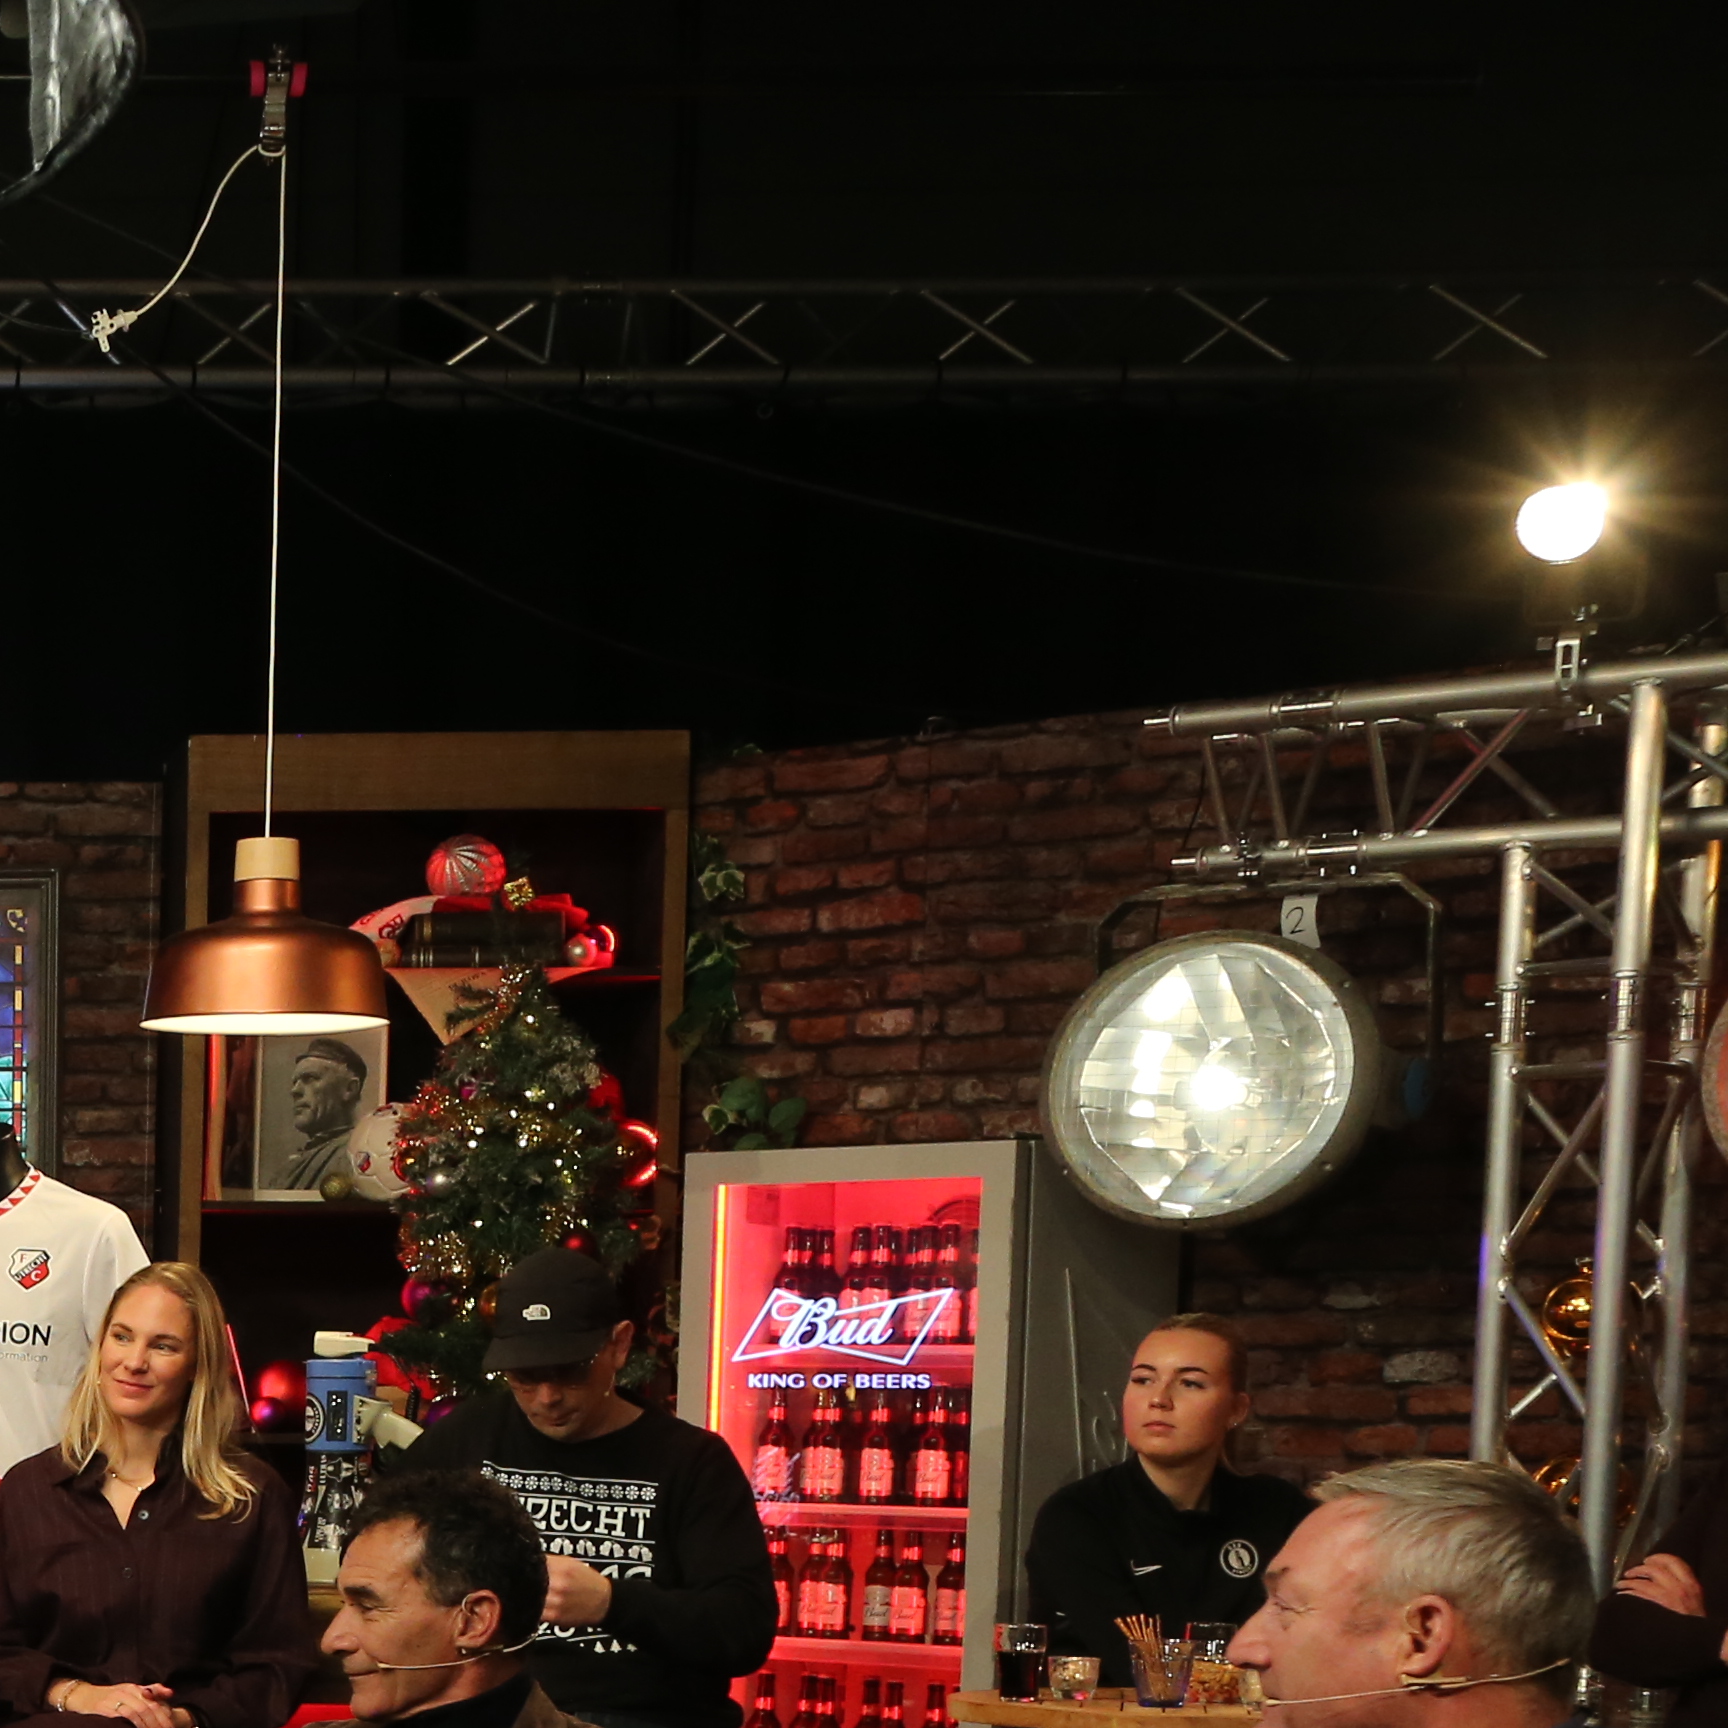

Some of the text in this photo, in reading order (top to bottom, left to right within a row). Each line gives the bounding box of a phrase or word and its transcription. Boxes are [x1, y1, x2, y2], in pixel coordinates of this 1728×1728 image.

[1285, 906, 1306, 935] 2
[30, 1269, 42, 1282] C
[770, 1296, 897, 1350] Bud
[747, 1373, 932, 1389] KING OF BEERS
[518, 1497, 651, 1539] RECHT
